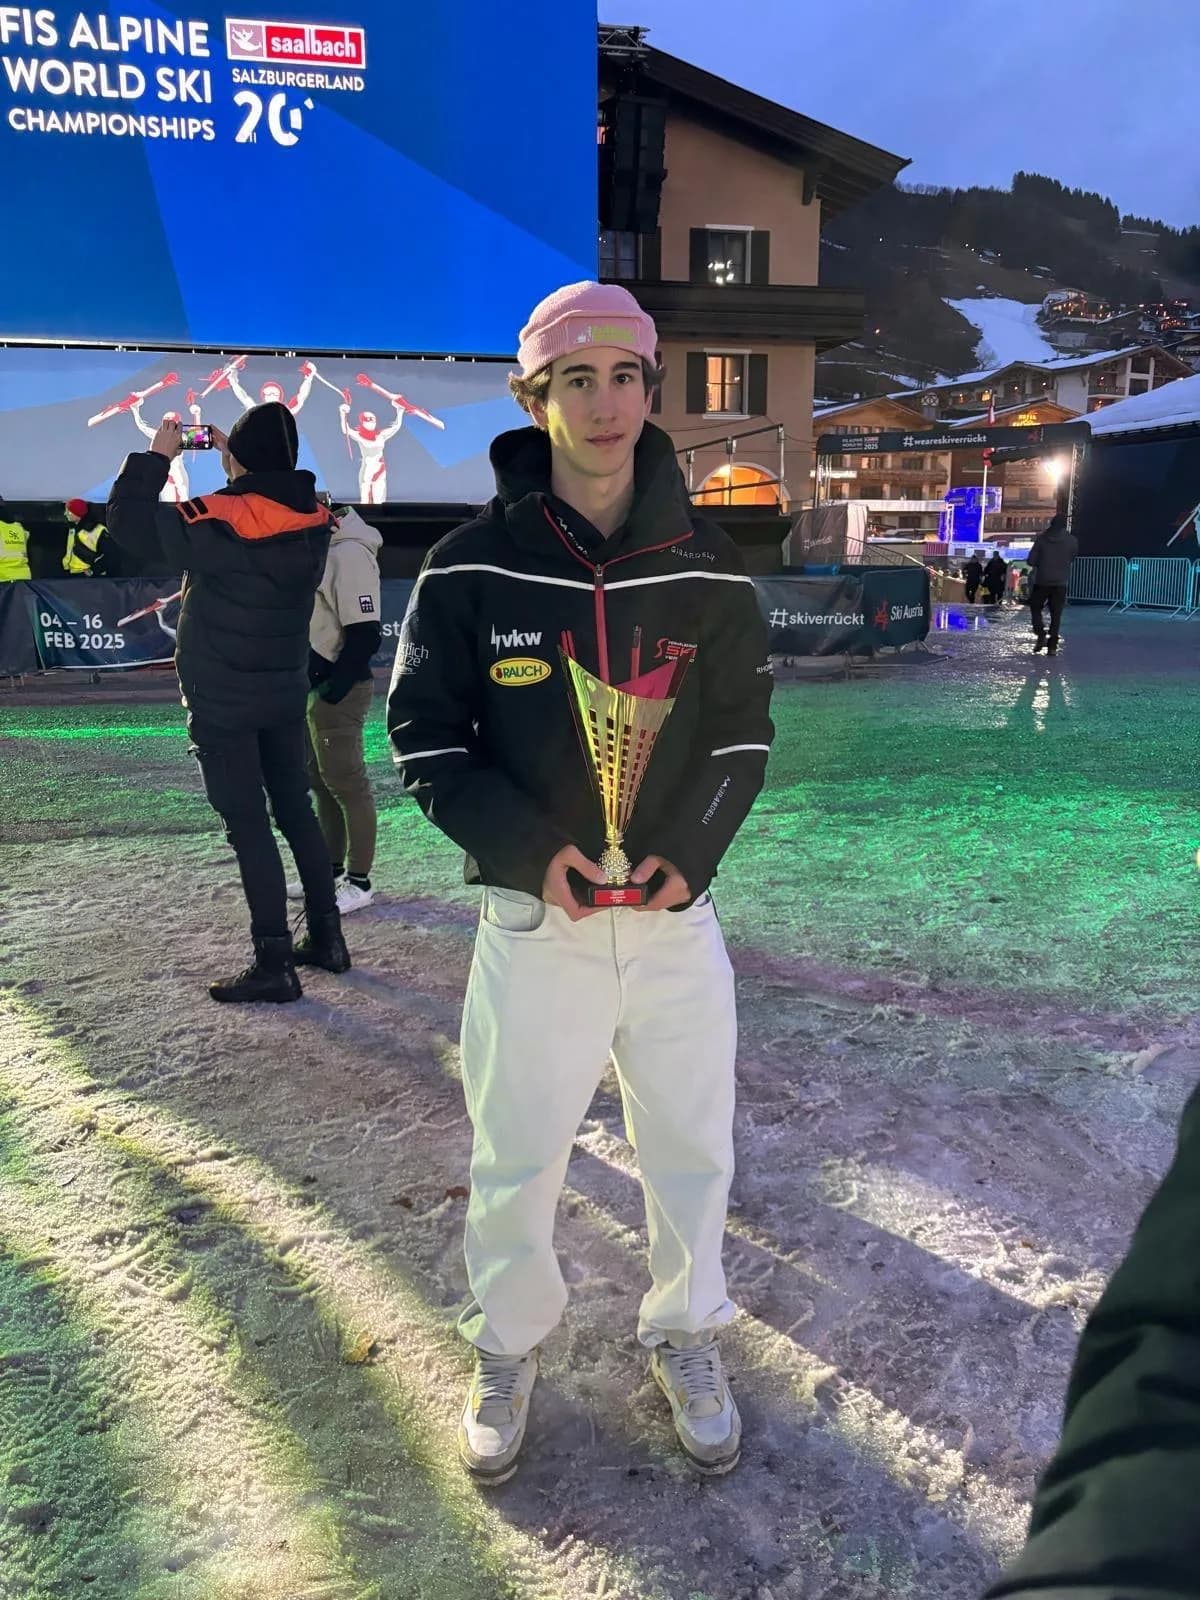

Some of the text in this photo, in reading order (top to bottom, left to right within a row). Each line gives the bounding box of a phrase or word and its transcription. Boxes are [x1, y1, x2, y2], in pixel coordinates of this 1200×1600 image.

[0, 7, 210, 57] FIS ALPINE
[270, 27, 357, 58] saalbach
[2, 56, 212, 103] WORLD SKI
[232, 68, 365, 91] SALZBURGERLAND
[8, 108, 216, 141] CHAMPIONSHIPS
[903, 434, 987, 447] #weareskiverrückt
[40, 612, 62, 628] 04
[82, 614, 103, 629] 16
[769, 608, 865, 628] #skiverrückt
[890, 605, 903, 622] Ski
[44, 631, 125, 649] FEB 2025
[498, 628, 542, 648] vkw
[502, 665, 543, 679] RAUCH
